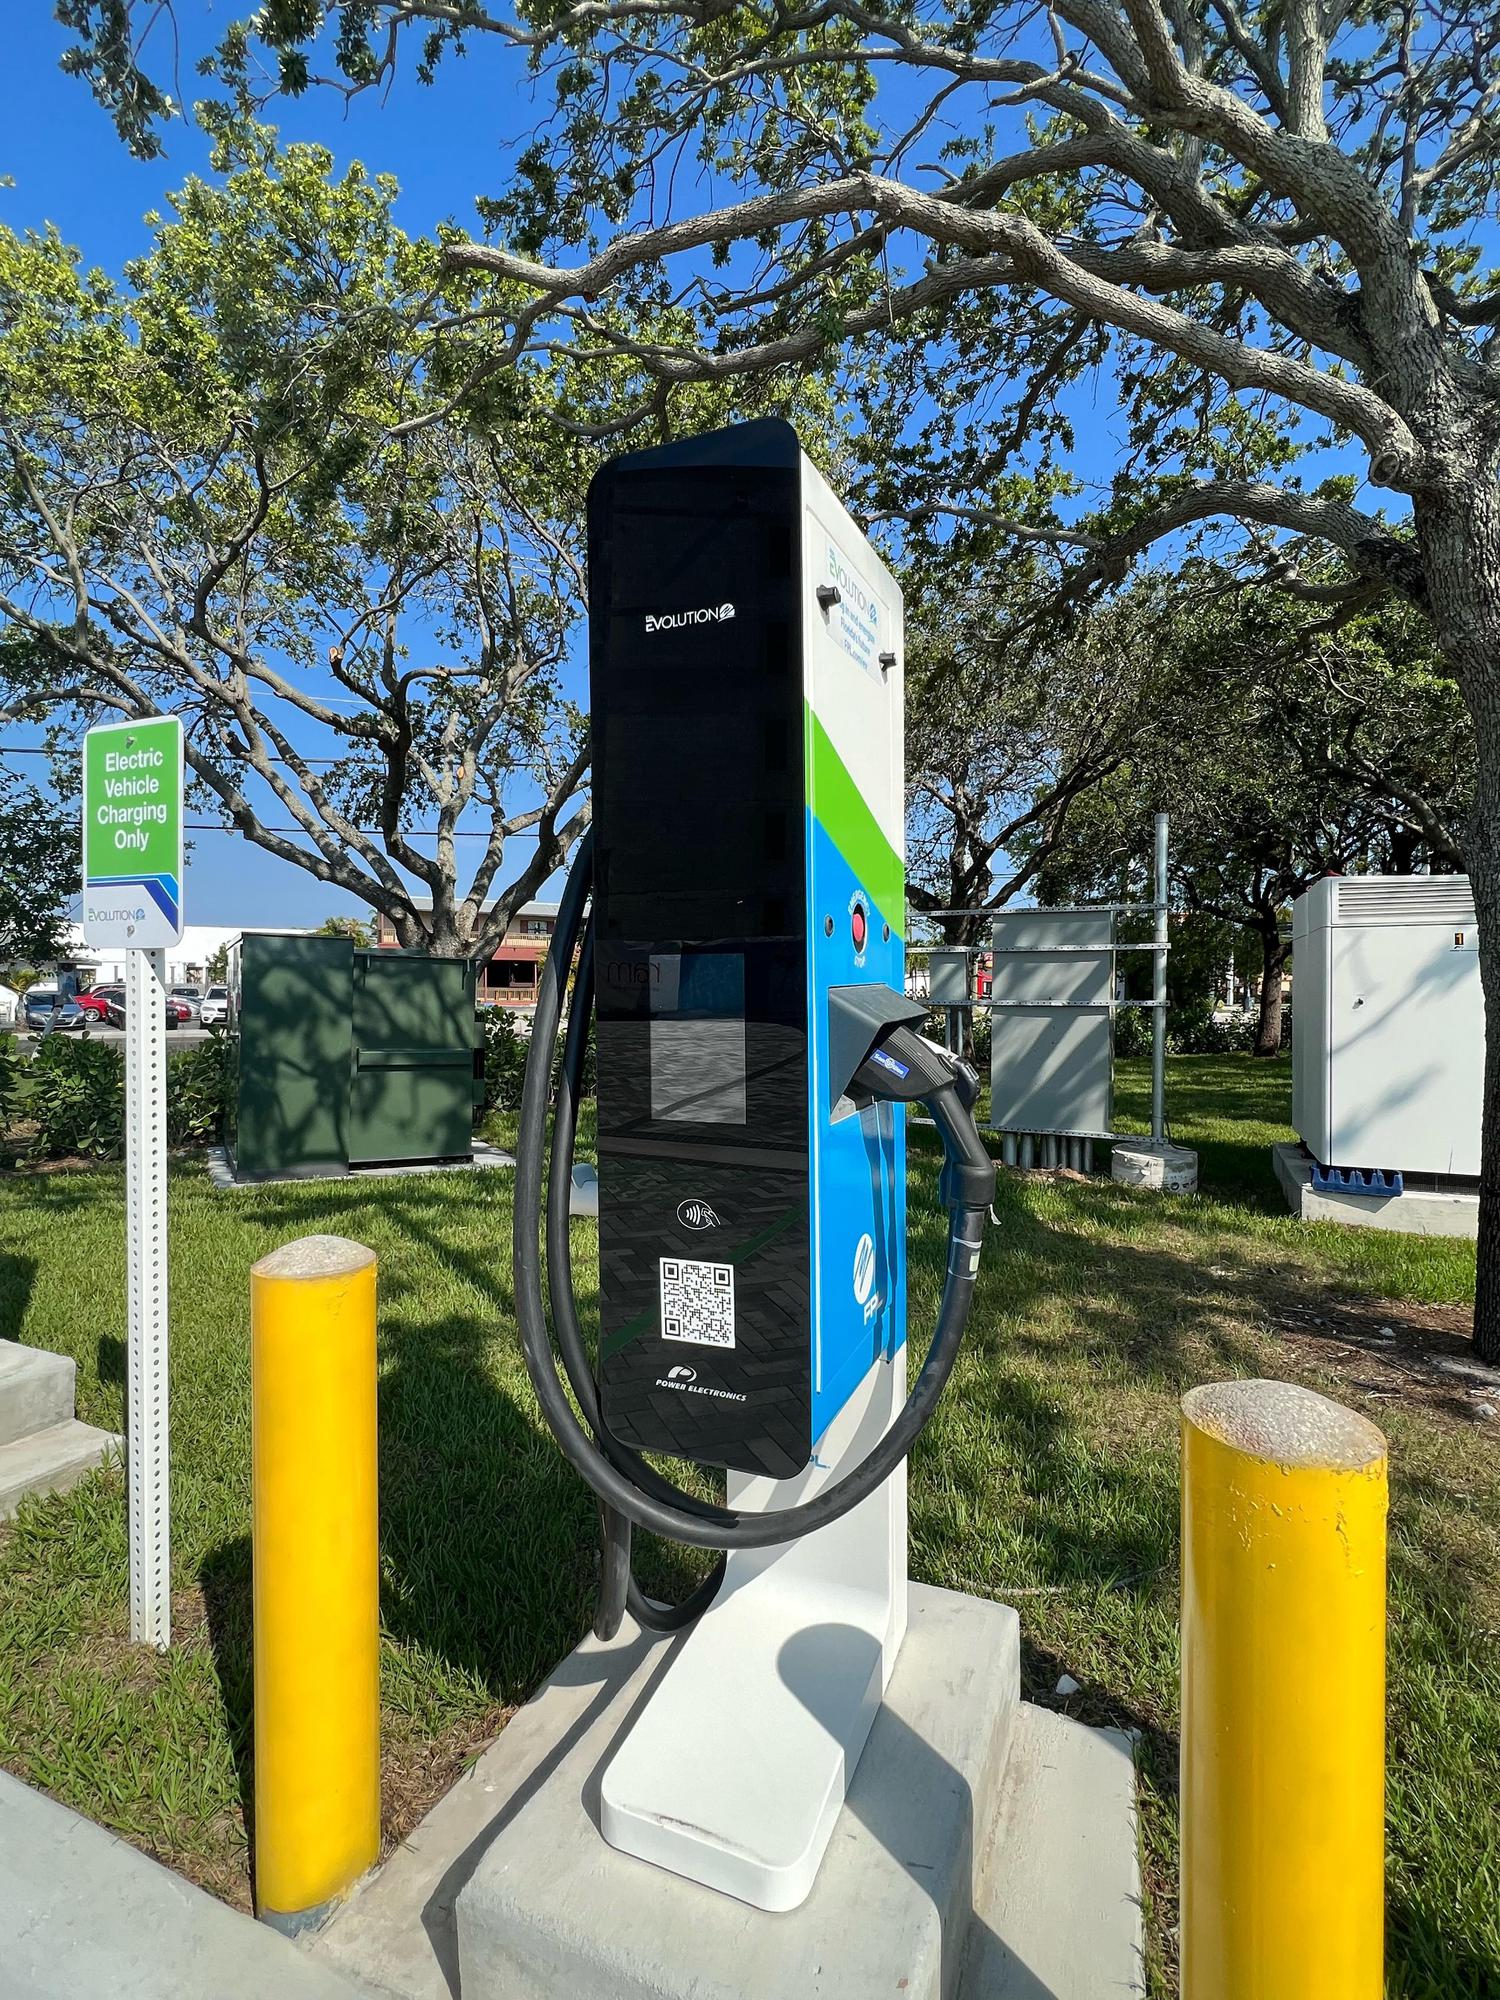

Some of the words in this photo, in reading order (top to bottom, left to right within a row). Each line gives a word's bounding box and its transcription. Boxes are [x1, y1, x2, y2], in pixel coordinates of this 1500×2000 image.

[829, 548, 871, 618] EVOLUTION
[645, 606, 719, 633] EVOLUTION
[105, 748, 163, 773] Electric
[104, 774, 160, 799] Vehicle
[97, 801, 168, 826] Charging
[114, 828, 150, 852] Only
[88, 908, 135, 922] EVOLUTION
[655, 1378, 688, 1391] POWER
[687, 1384, 748, 1402] ELECTRONICS
